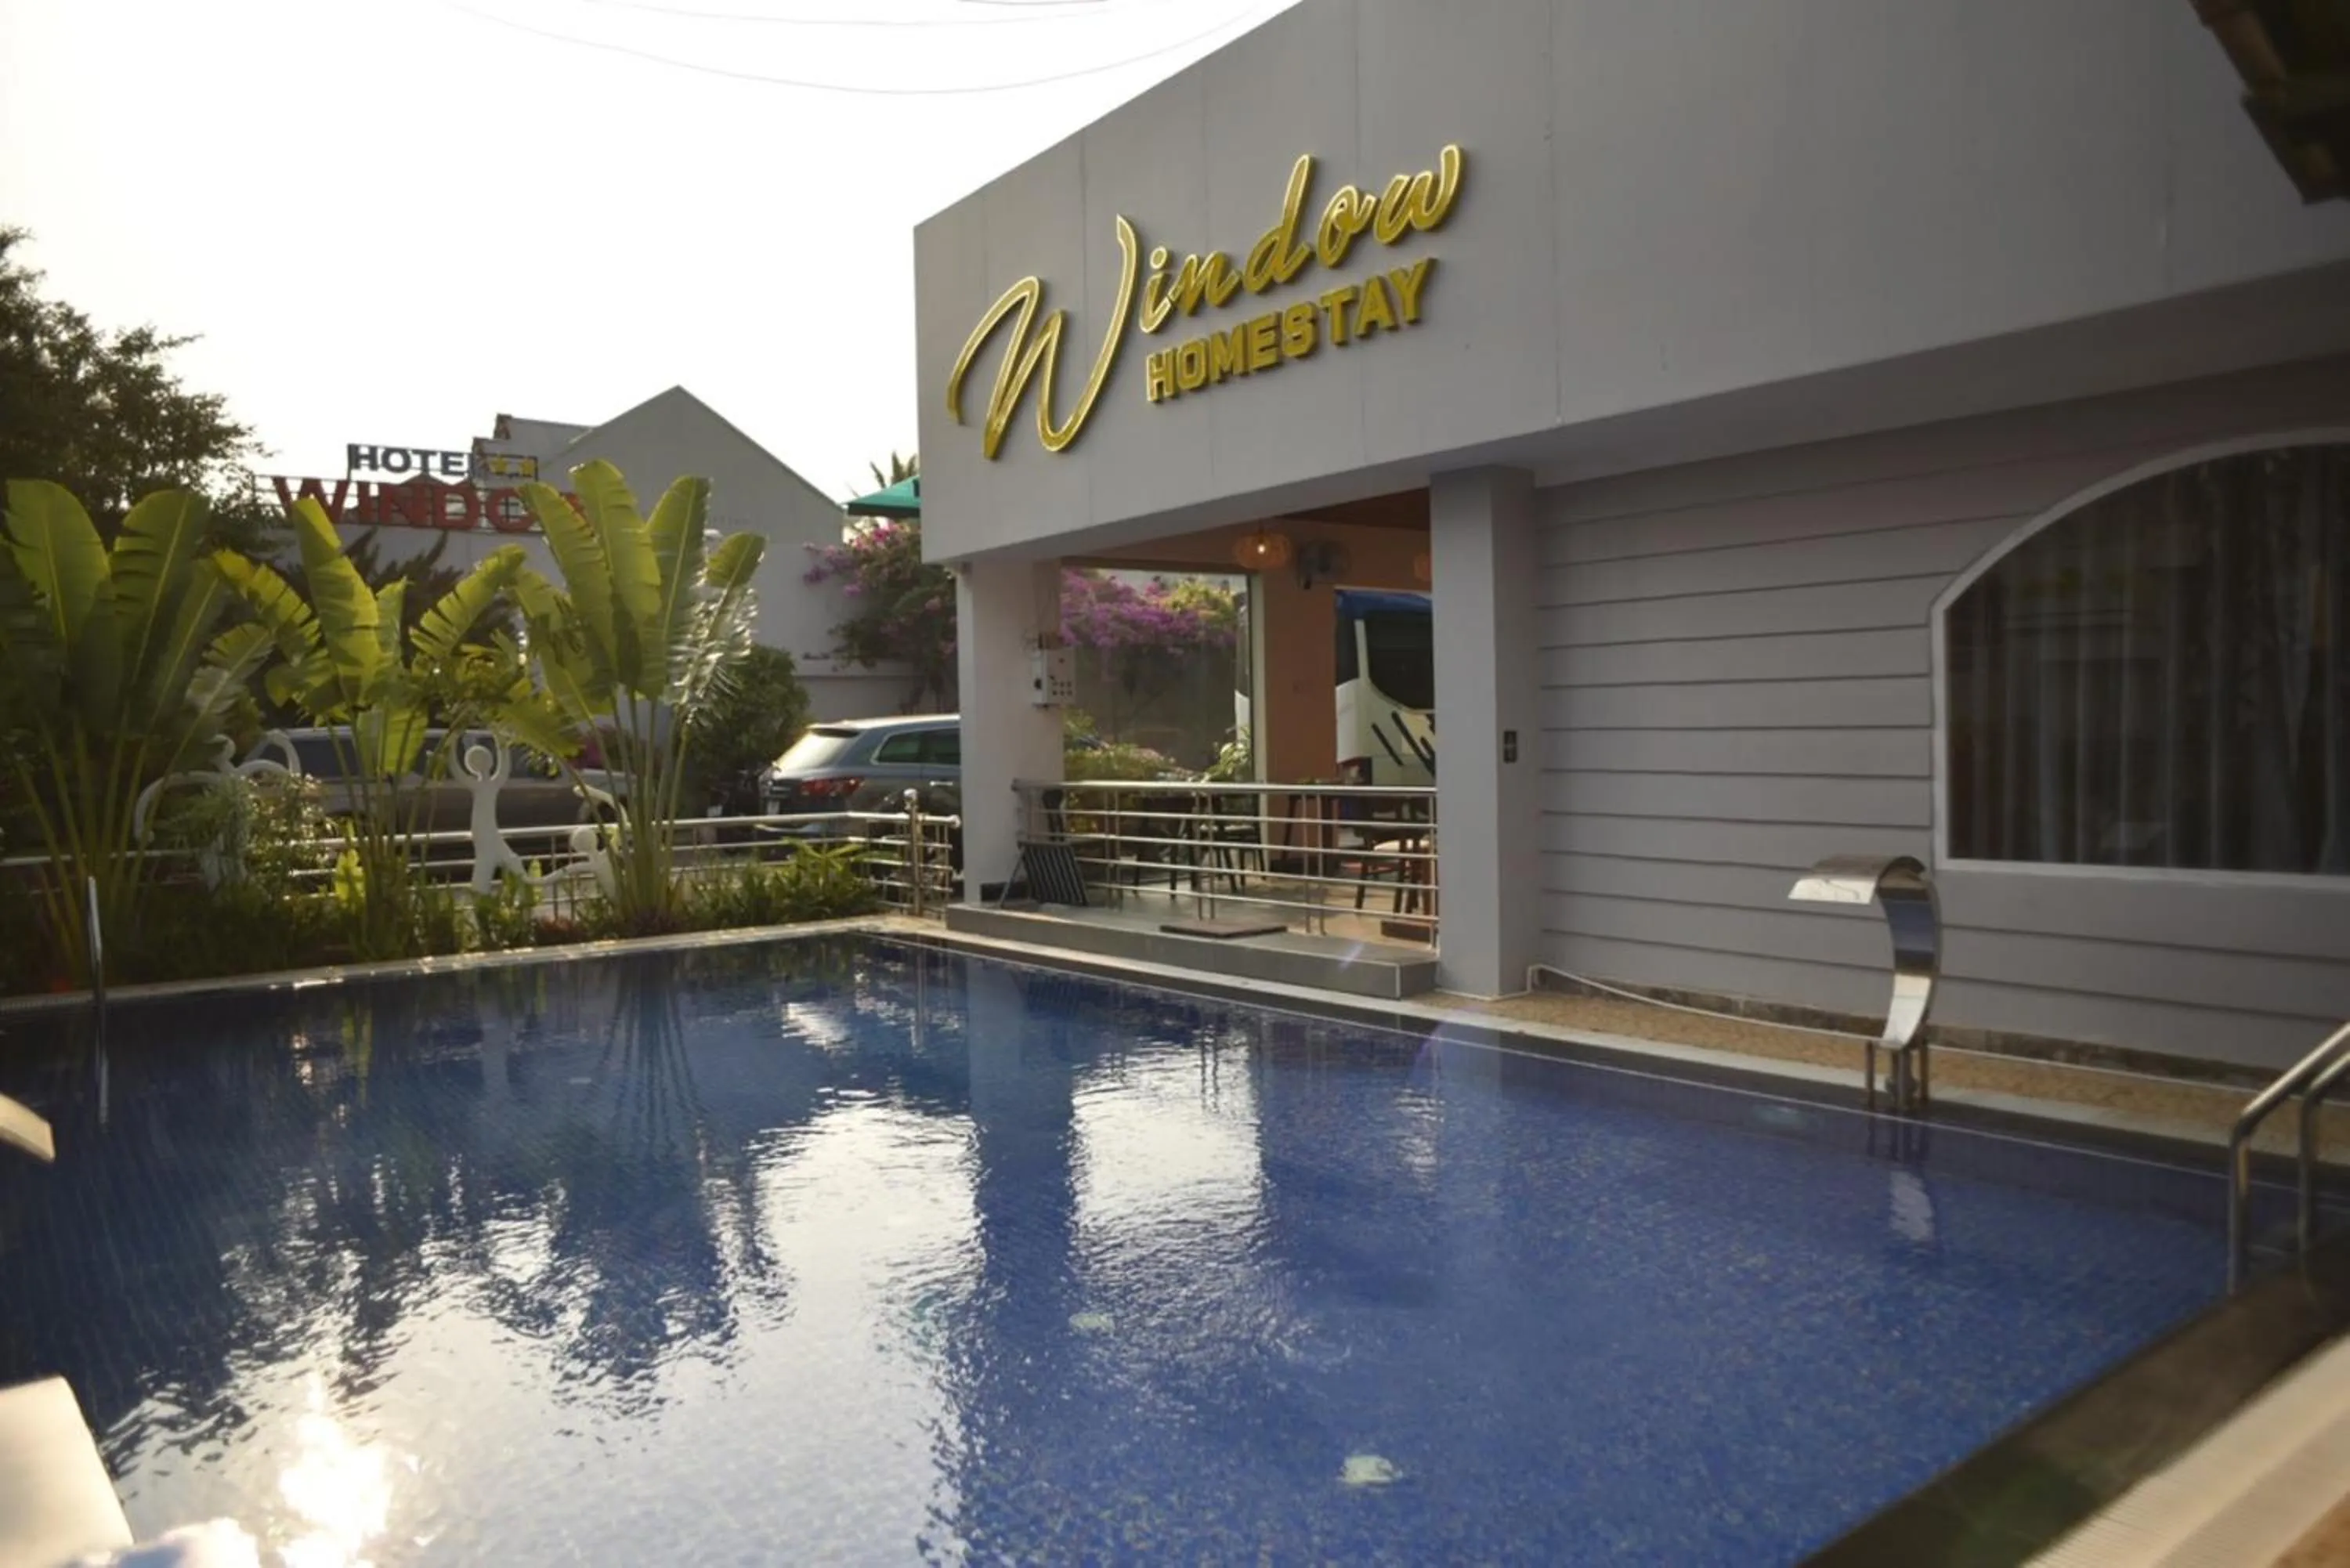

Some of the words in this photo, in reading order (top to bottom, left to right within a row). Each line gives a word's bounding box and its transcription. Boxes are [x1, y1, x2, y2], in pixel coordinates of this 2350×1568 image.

[946, 144, 1463, 461] Window
[1145, 258, 1437, 403] HOMESTAY
[272, 475, 589, 535] WINDO
